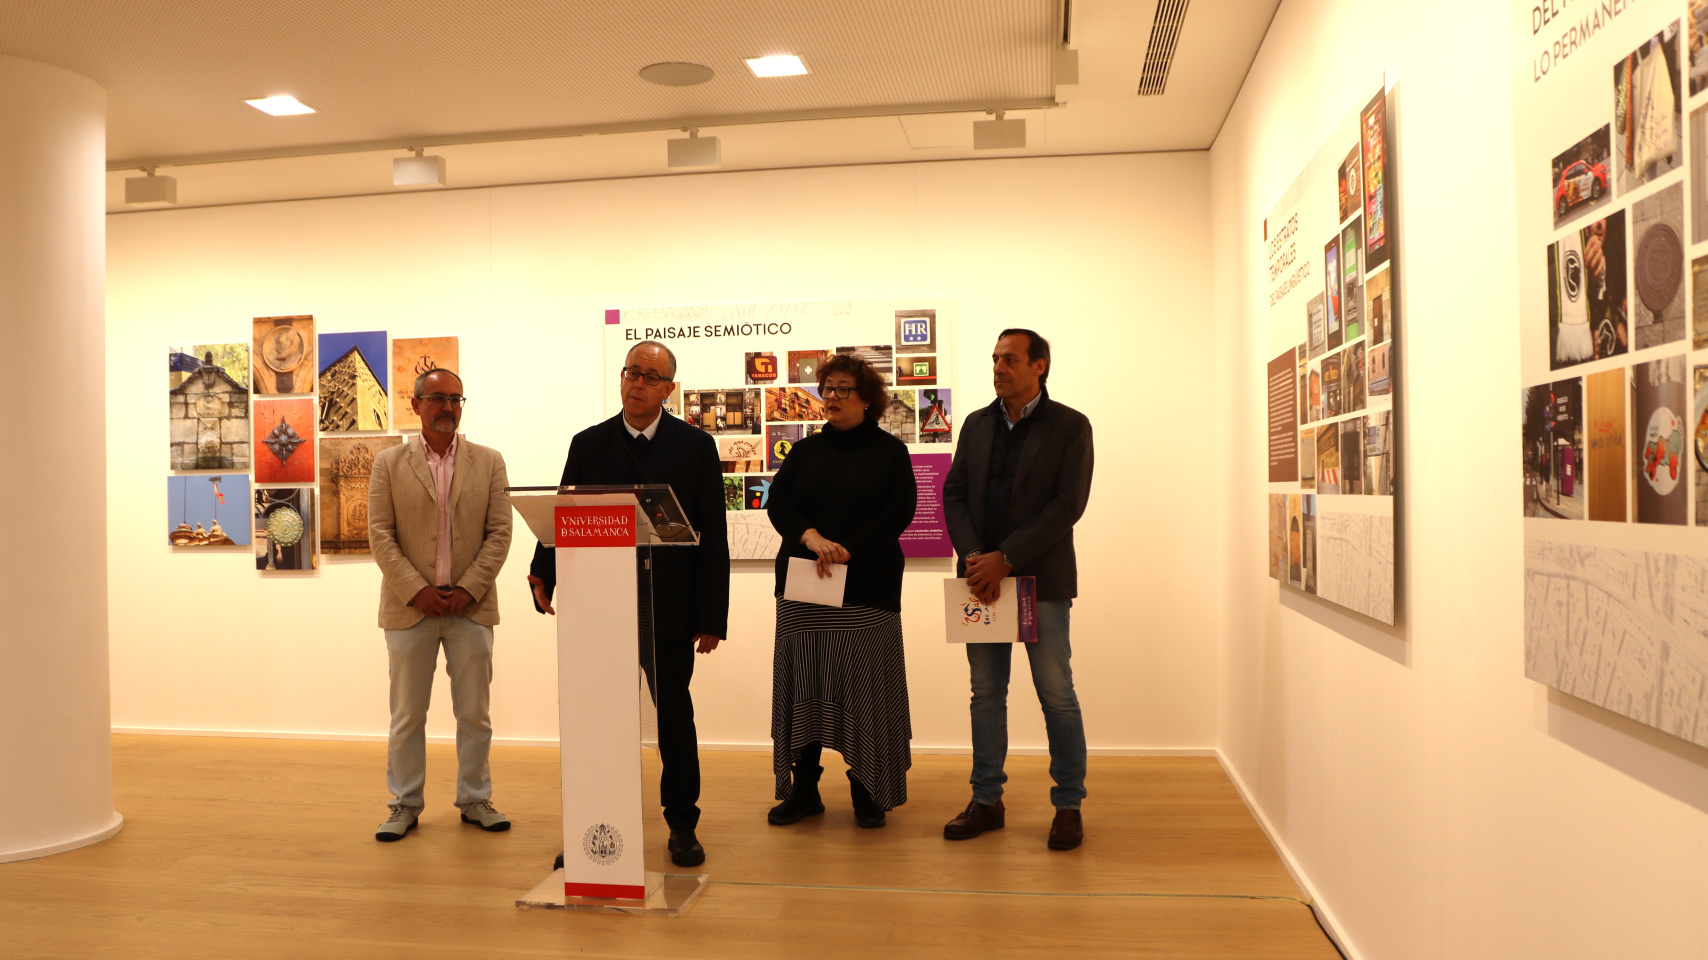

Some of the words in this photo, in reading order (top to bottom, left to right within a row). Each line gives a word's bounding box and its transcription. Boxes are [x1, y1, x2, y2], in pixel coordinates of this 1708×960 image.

[1532, 0, 1559, 36] DEL
[1533, 50, 1551, 83] LO
[625, 328, 641, 340] EL
[645, 325, 701, 340] PAISAJE
[704, 322, 792, 338] SEMIÓTICO
[904, 322, 927, 335] HR
[569, 527, 629, 537] SALAMANCA
